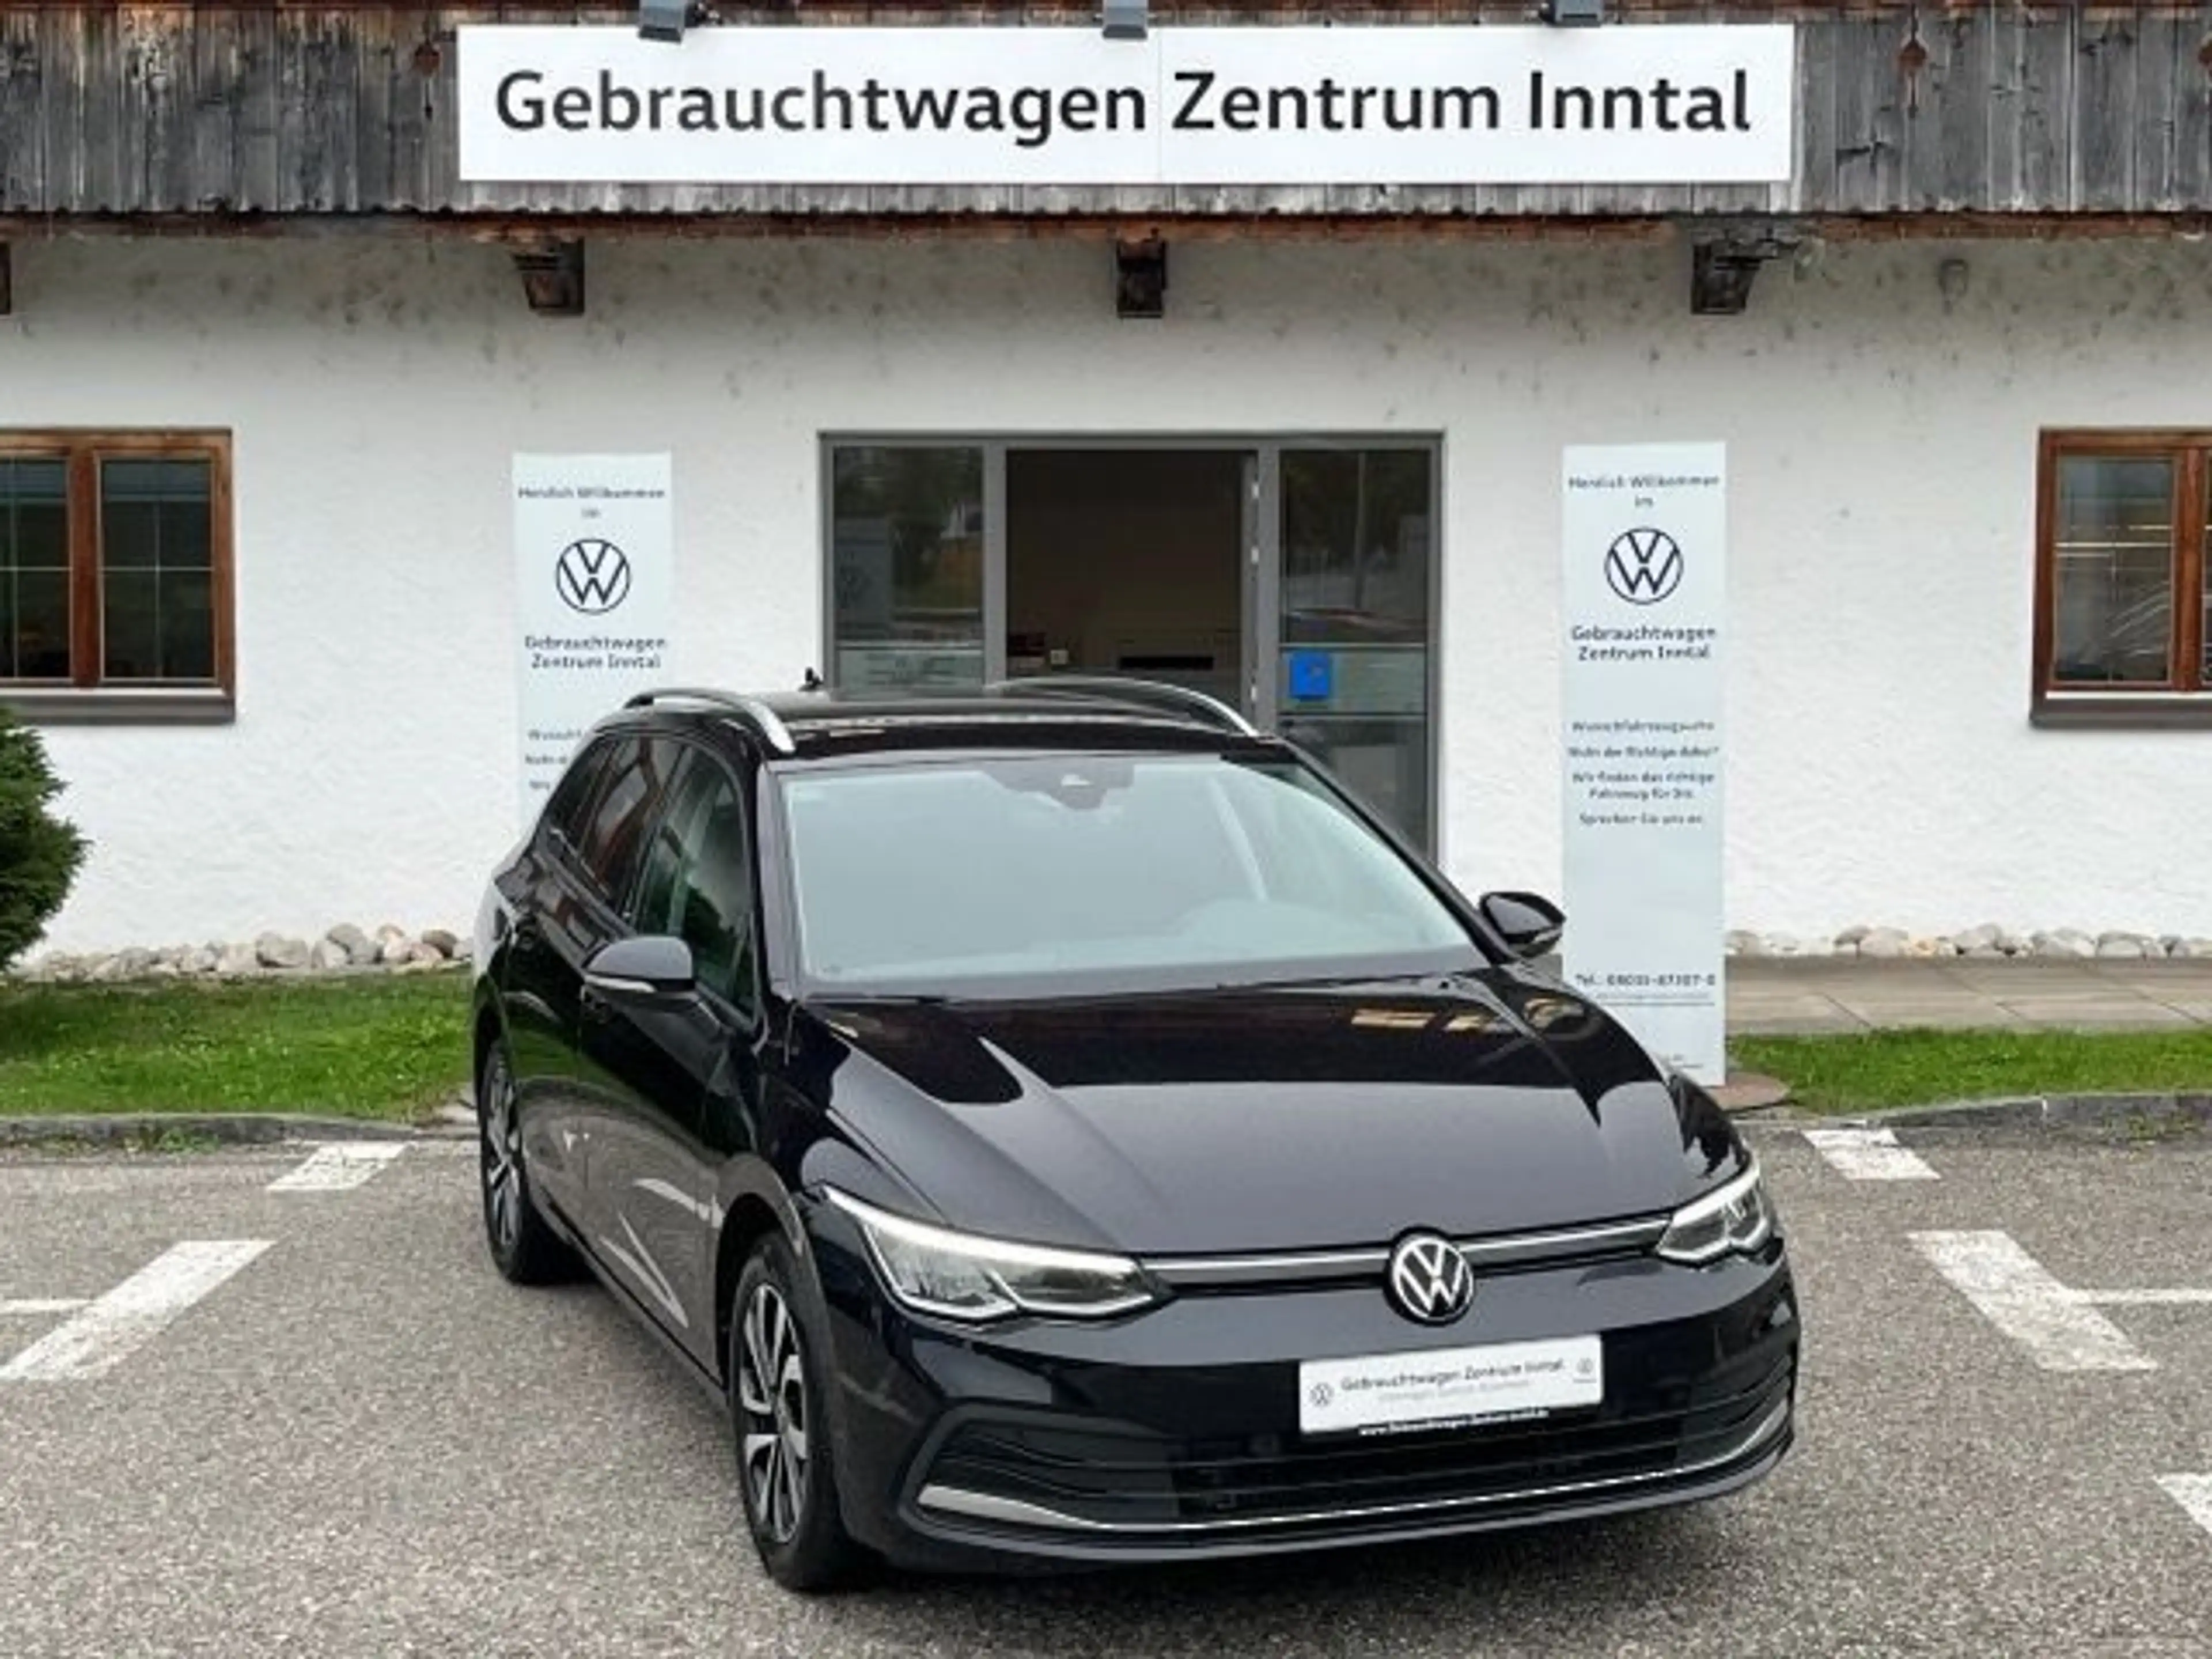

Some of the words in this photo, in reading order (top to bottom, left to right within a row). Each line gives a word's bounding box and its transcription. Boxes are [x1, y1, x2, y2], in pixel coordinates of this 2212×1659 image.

[495, 67, 1147, 147] Gebrauchtwagen
[1172, 70, 1501, 131] Zentrum
[1529, 69, 1752, 131] Inntal
[1571, 625, 1717, 643] Gebrauchtwagen
[525, 635, 665, 653] Gebrauchtwagen
[1578, 646, 1653, 661] Zentrum
[1658, 645, 1711, 660] Inntal
[531, 653, 603, 669] Zentrum
[608, 653, 661, 668] Inntal
[1396, 1240, 1470, 1316] VW
